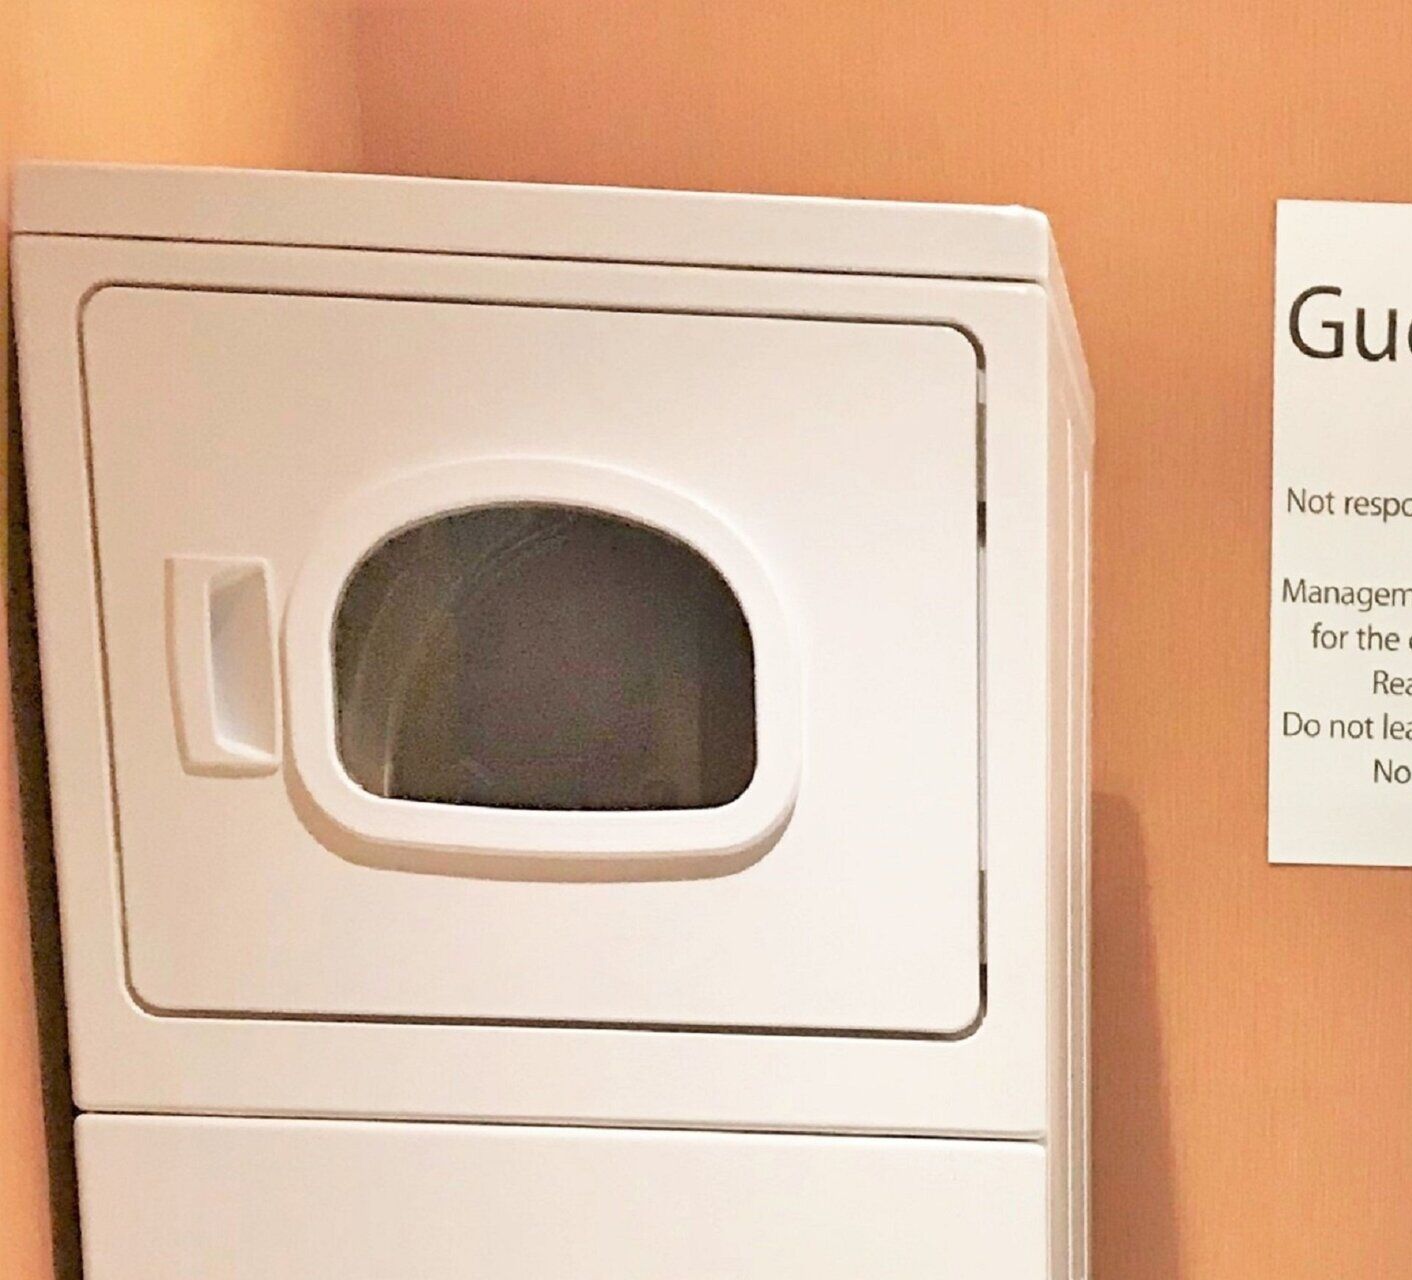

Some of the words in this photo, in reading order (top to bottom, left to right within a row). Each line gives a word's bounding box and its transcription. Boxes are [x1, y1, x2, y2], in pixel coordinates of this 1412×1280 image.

[1287, 487, 1335, 515] Not
[1311, 621, 1349, 649] for
[1356, 625, 1400, 652] the
[1283, 711, 1321, 738] Do
[1330, 718, 1374, 740] not
[1374, 759, 1412, 784] No
